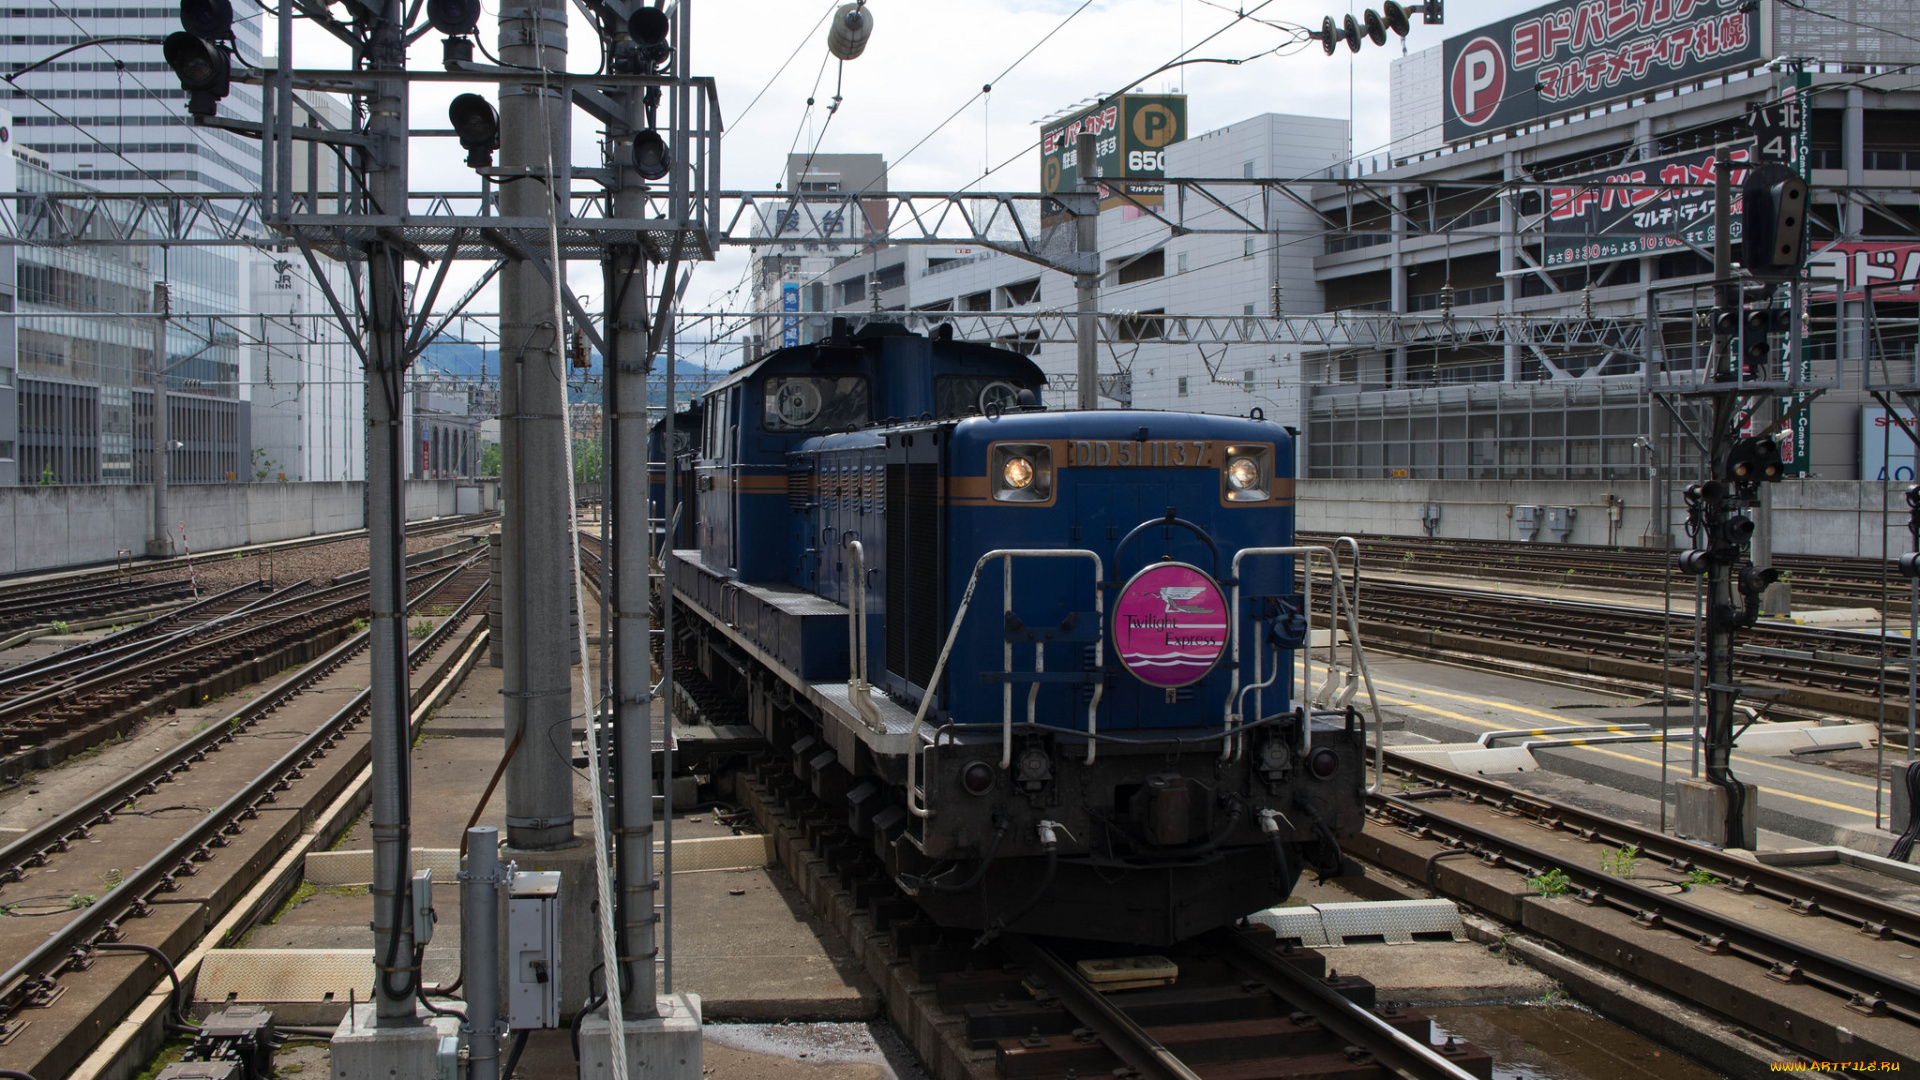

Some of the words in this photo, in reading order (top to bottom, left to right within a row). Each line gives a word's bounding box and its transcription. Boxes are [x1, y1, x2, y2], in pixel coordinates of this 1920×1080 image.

[1537, 15, 1749, 101] マルチメディア札幌
[1464, 49, 1496, 116] P
[1145, 111, 1167, 140] P
[1800, 90, 1809, 180] Yodobashi-Camer
[1763, 136, 1786, 159] 4
[1048, 164, 1057, 189] P
[275, 274, 291, 283] JR
[1122, 612, 1180, 649] Twilight
[1165, 631, 1216, 649] Express
